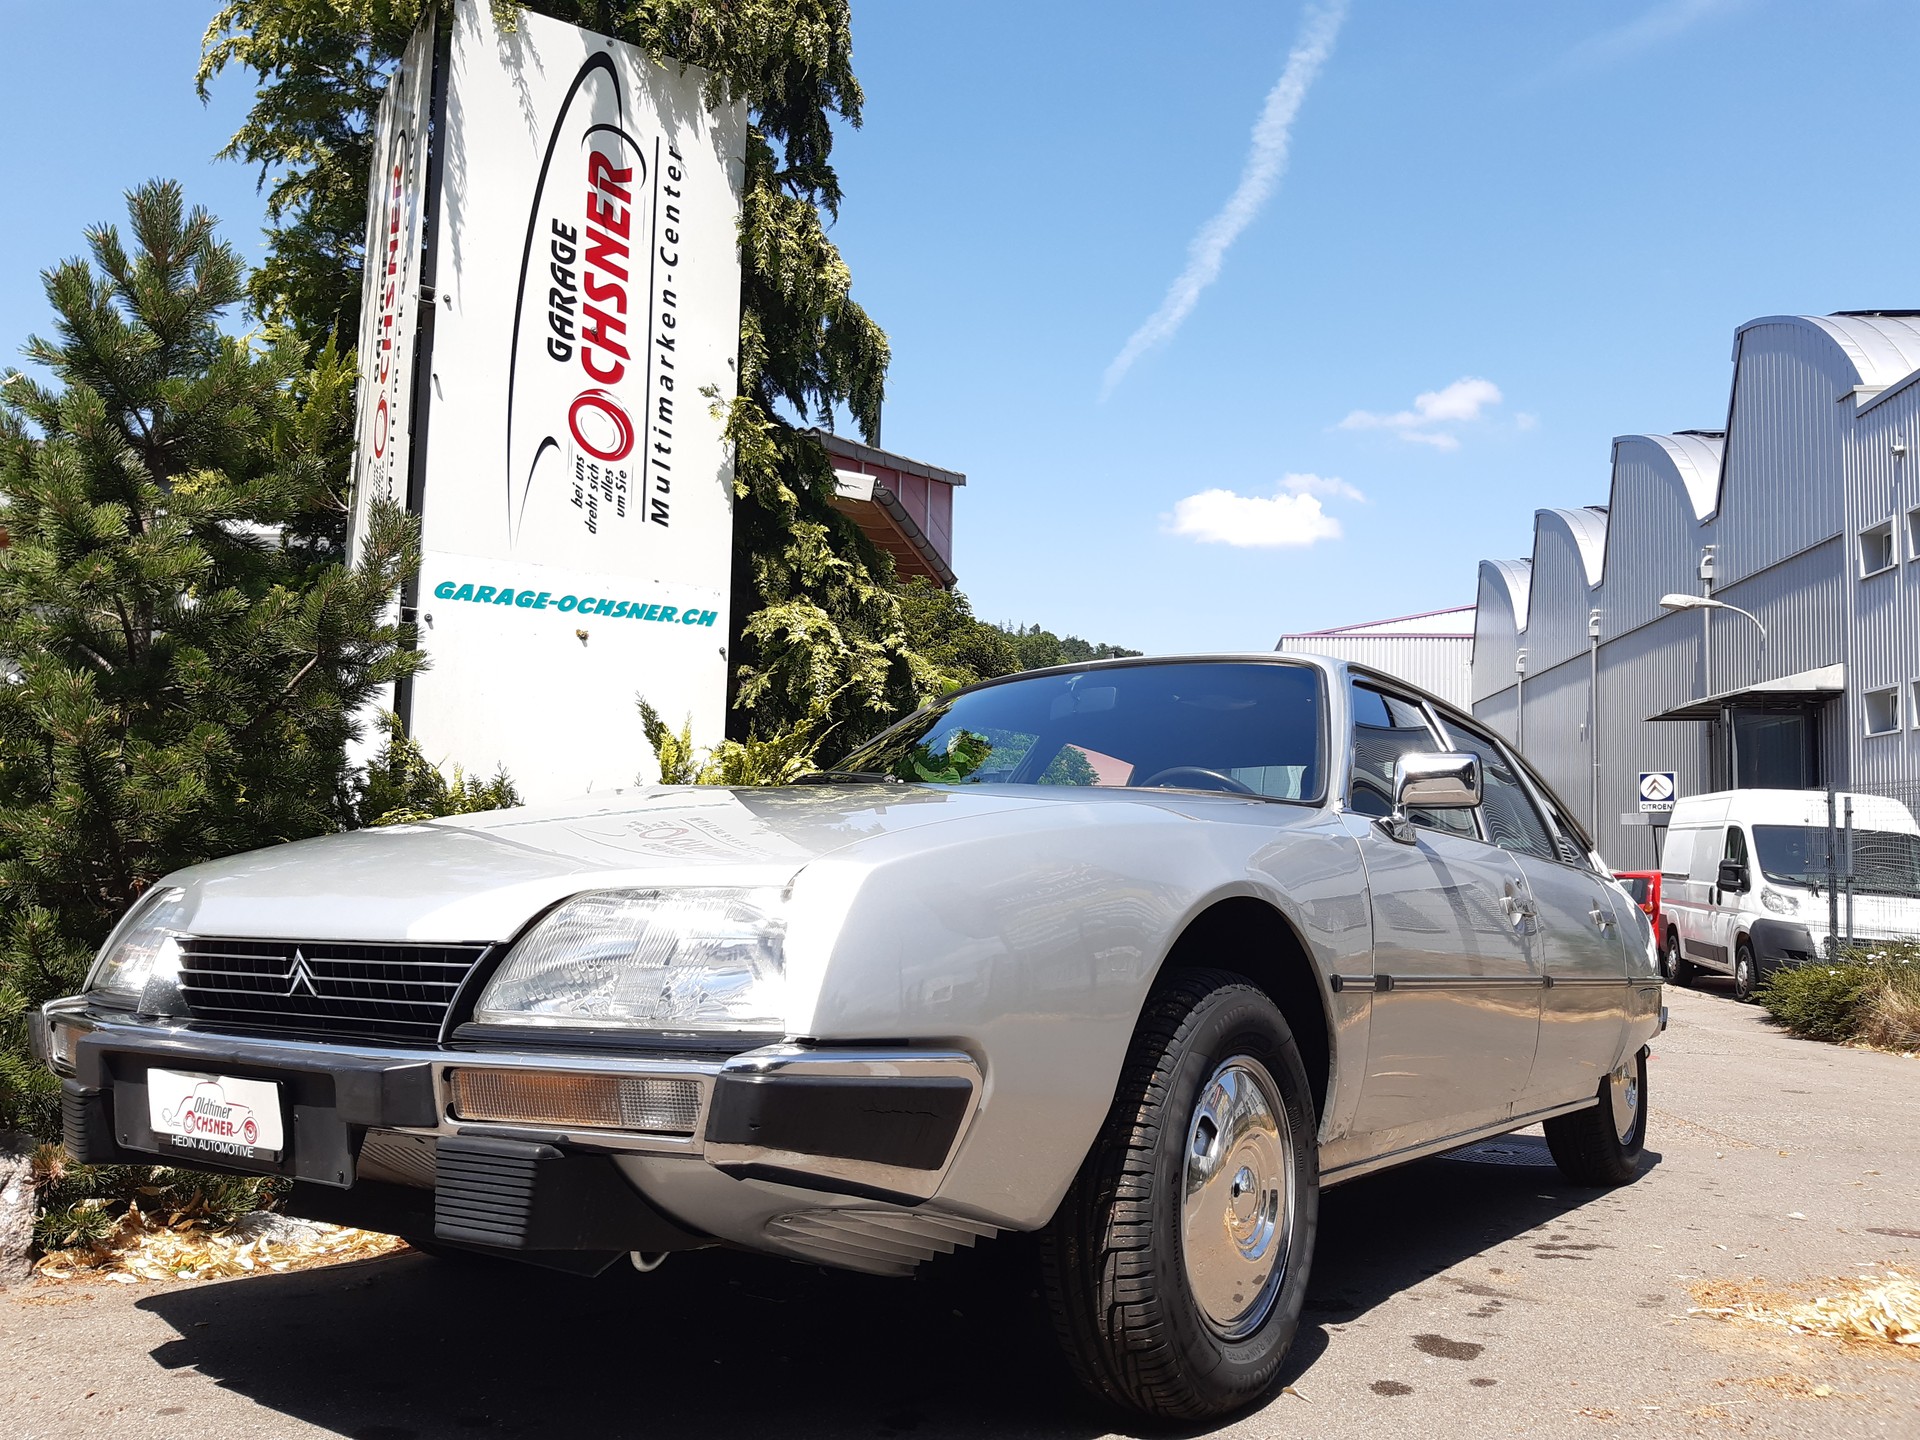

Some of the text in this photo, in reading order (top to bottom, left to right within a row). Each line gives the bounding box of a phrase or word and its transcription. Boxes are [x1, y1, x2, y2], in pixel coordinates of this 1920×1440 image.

[547, 218, 578, 362] GARAGE
[651, 145, 684, 528] Multimarken-Center
[570, 454, 585, 509] bei uns
[584, 463, 600, 535] dreht sich
[600, 467, 614, 503] alles
[615, 469, 627, 518] um Sie
[433, 580, 719, 627] GARAGE-OCHSNER.CH
[193, 1096, 233, 1120] Oldtimer
[171, 1135, 255, 1158] HEDIN AUTOMOTIVE
